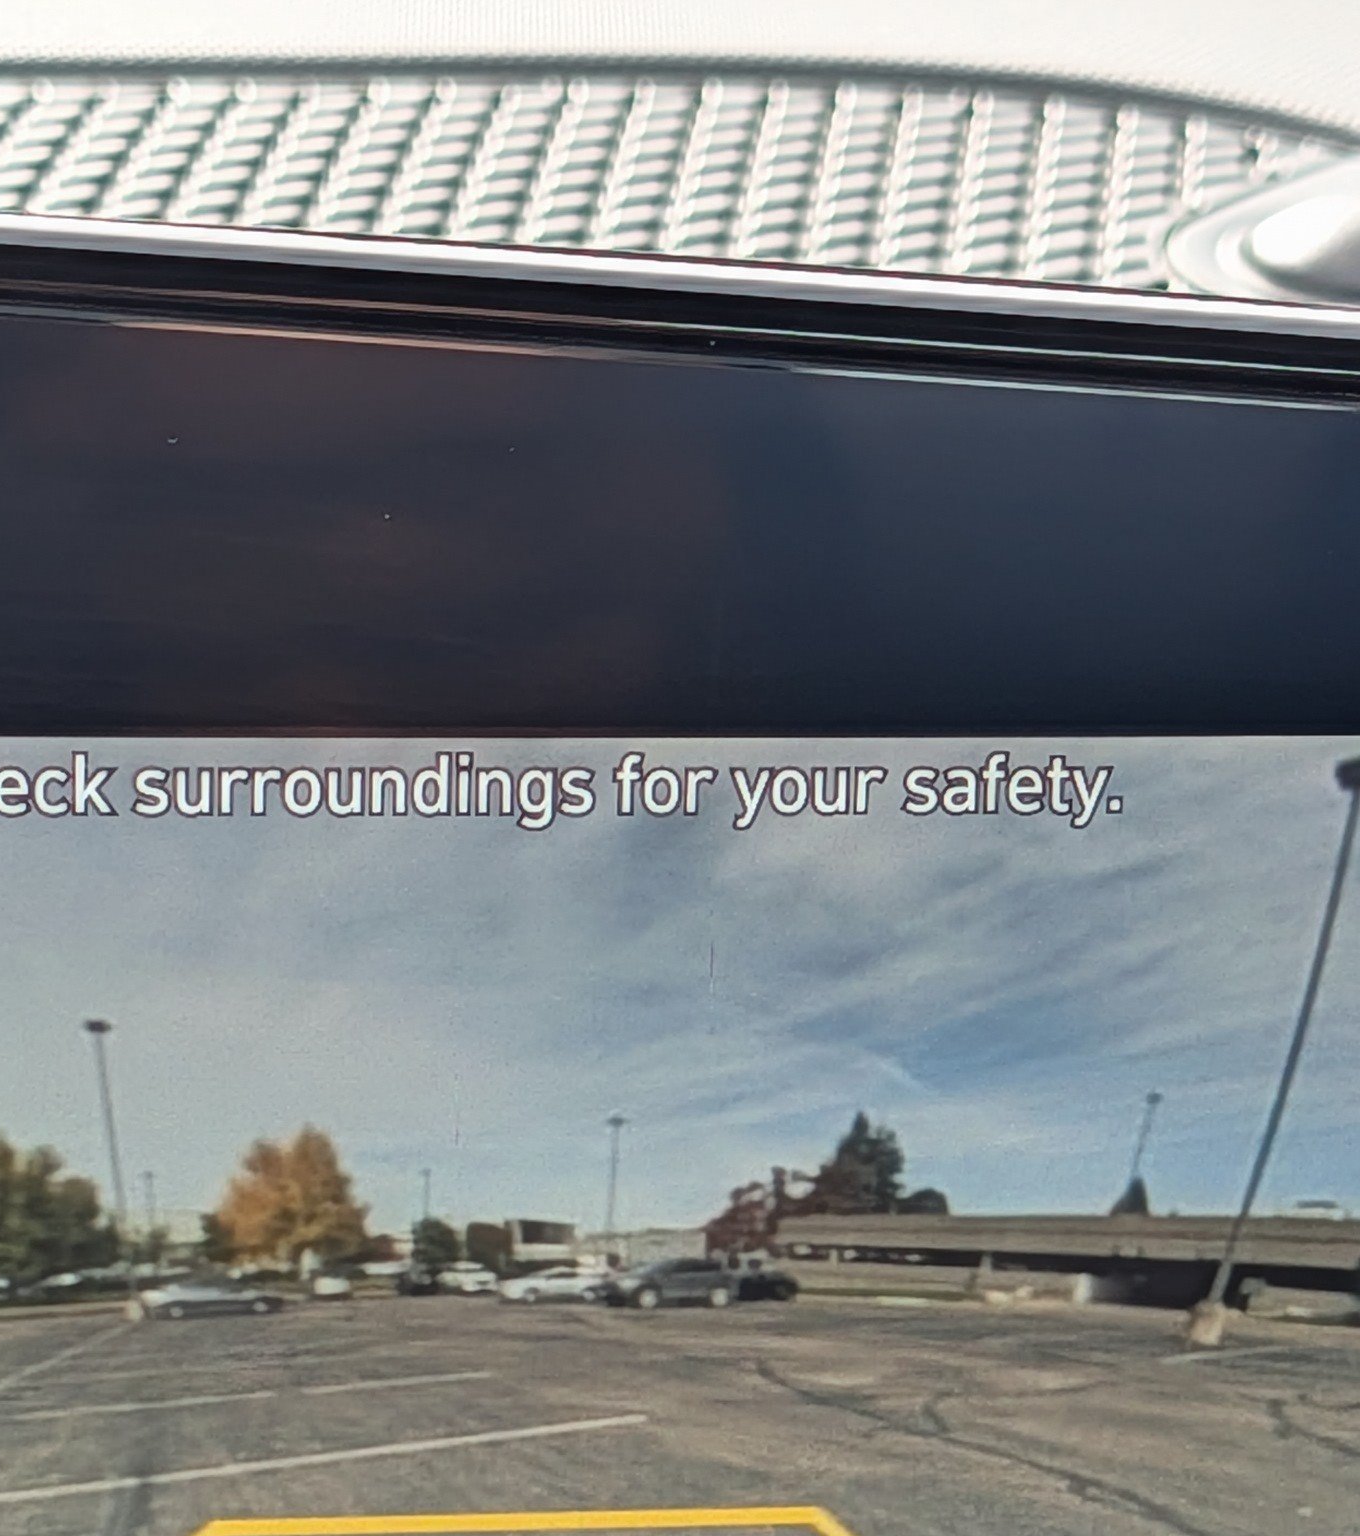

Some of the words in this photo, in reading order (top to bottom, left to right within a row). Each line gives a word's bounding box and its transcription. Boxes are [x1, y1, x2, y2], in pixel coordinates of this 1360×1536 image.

[130, 751, 596, 829] surroundings
[615, 752, 719, 816] for
[730, 764, 885, 829] your
[899, 750, 1124, 829] safety.
